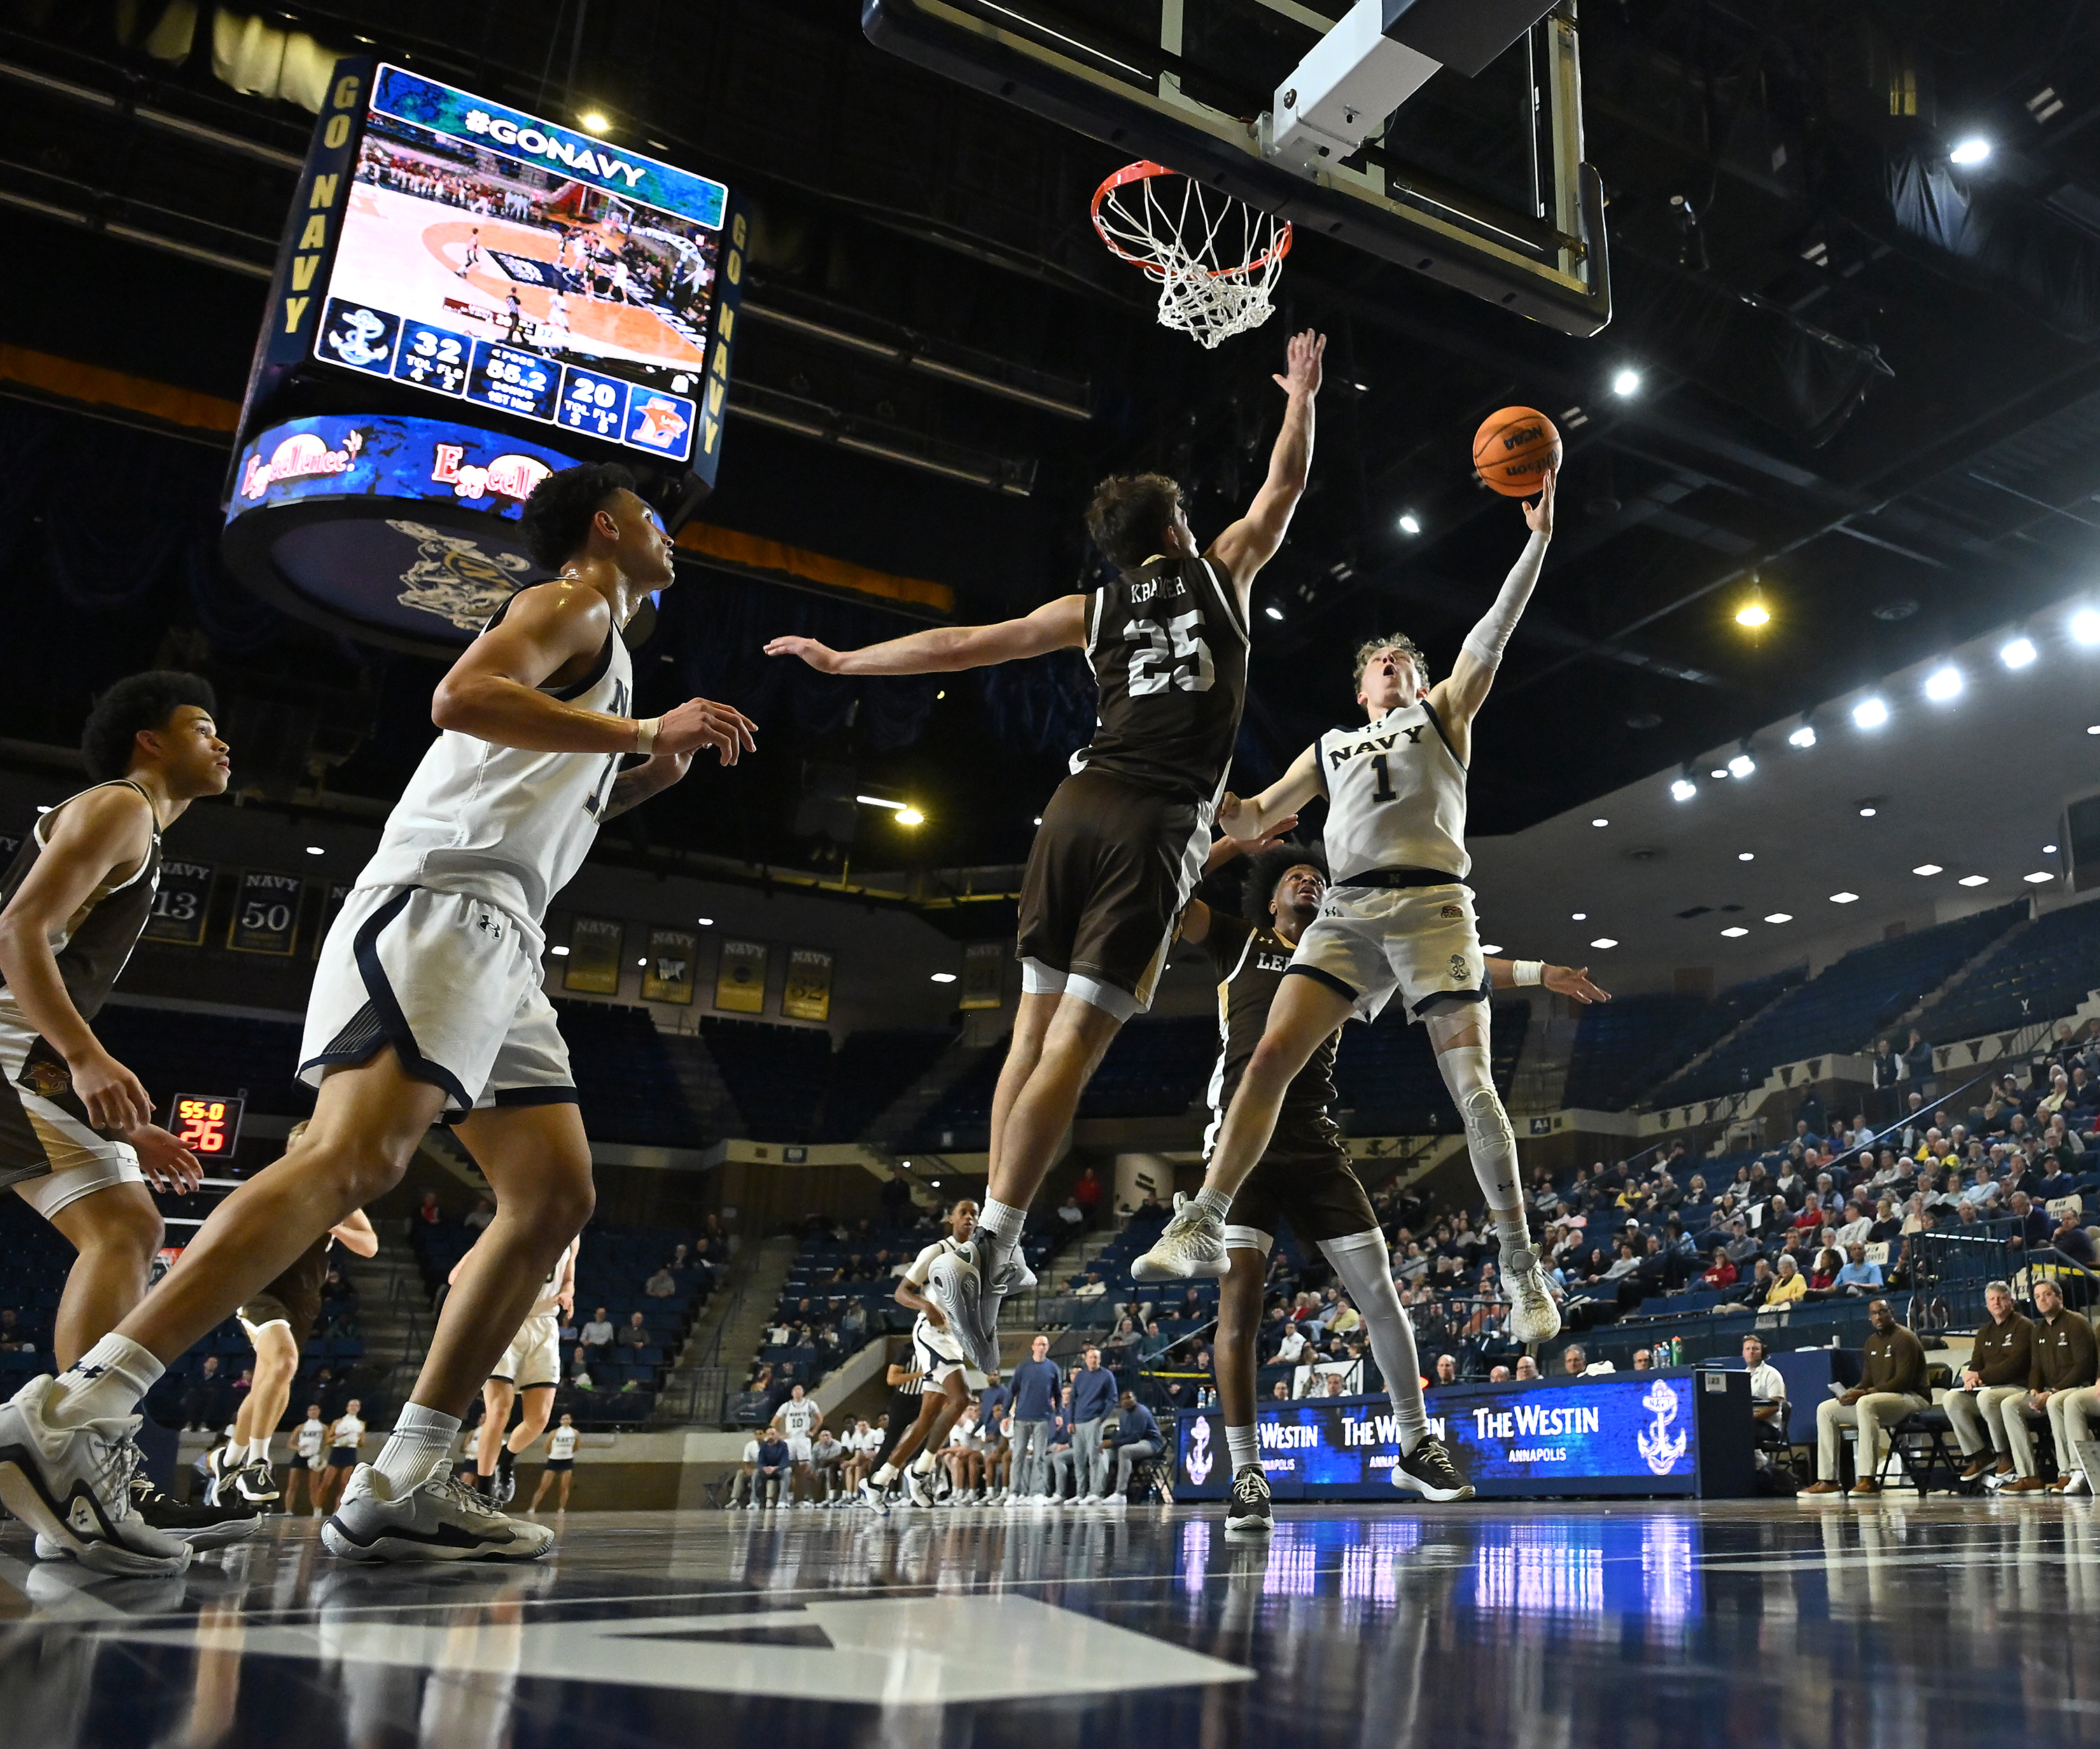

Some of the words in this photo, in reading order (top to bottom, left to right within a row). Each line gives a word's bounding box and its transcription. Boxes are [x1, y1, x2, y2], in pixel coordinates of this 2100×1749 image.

[324, 75, 360, 149] GO
[465, 109, 646, 188] #GONAVY
[285, 173, 339, 333] NAVY
[414, 331, 462, 365] 32
[486, 358, 547, 392] 55.2
[704, 302, 734, 454] NAVY
[571, 377, 616, 408] 20
[1131, 576, 1186, 604] KRAMER
[1123, 608, 1215, 697] 25
[1328, 725, 1424, 771] NAVY
[1371, 753, 1397, 804] 1
[246, 875, 299, 891] NAVY
[152, 891, 198, 920] 13
[242, 902, 290, 931] 50
[576, 920, 620, 938] NAVY
[652, 932, 696, 949] NAVY
[724, 943, 765, 960] NAVY
[792, 951, 832, 968] NAVY
[180, 1120, 225, 1151] 26
[792, 1418, 804, 1428] 10
[1260, 1422, 1319, 1449] WESTIN
[1341, 1417, 1375, 1446] THE
[1473, 1407, 1514, 1440] THE
[1513, 1405, 1600, 1436] WESTIN
[1369, 1455, 1399, 1468] ANNAP
[1508, 1447, 1567, 1463] ANNAPOLIS
